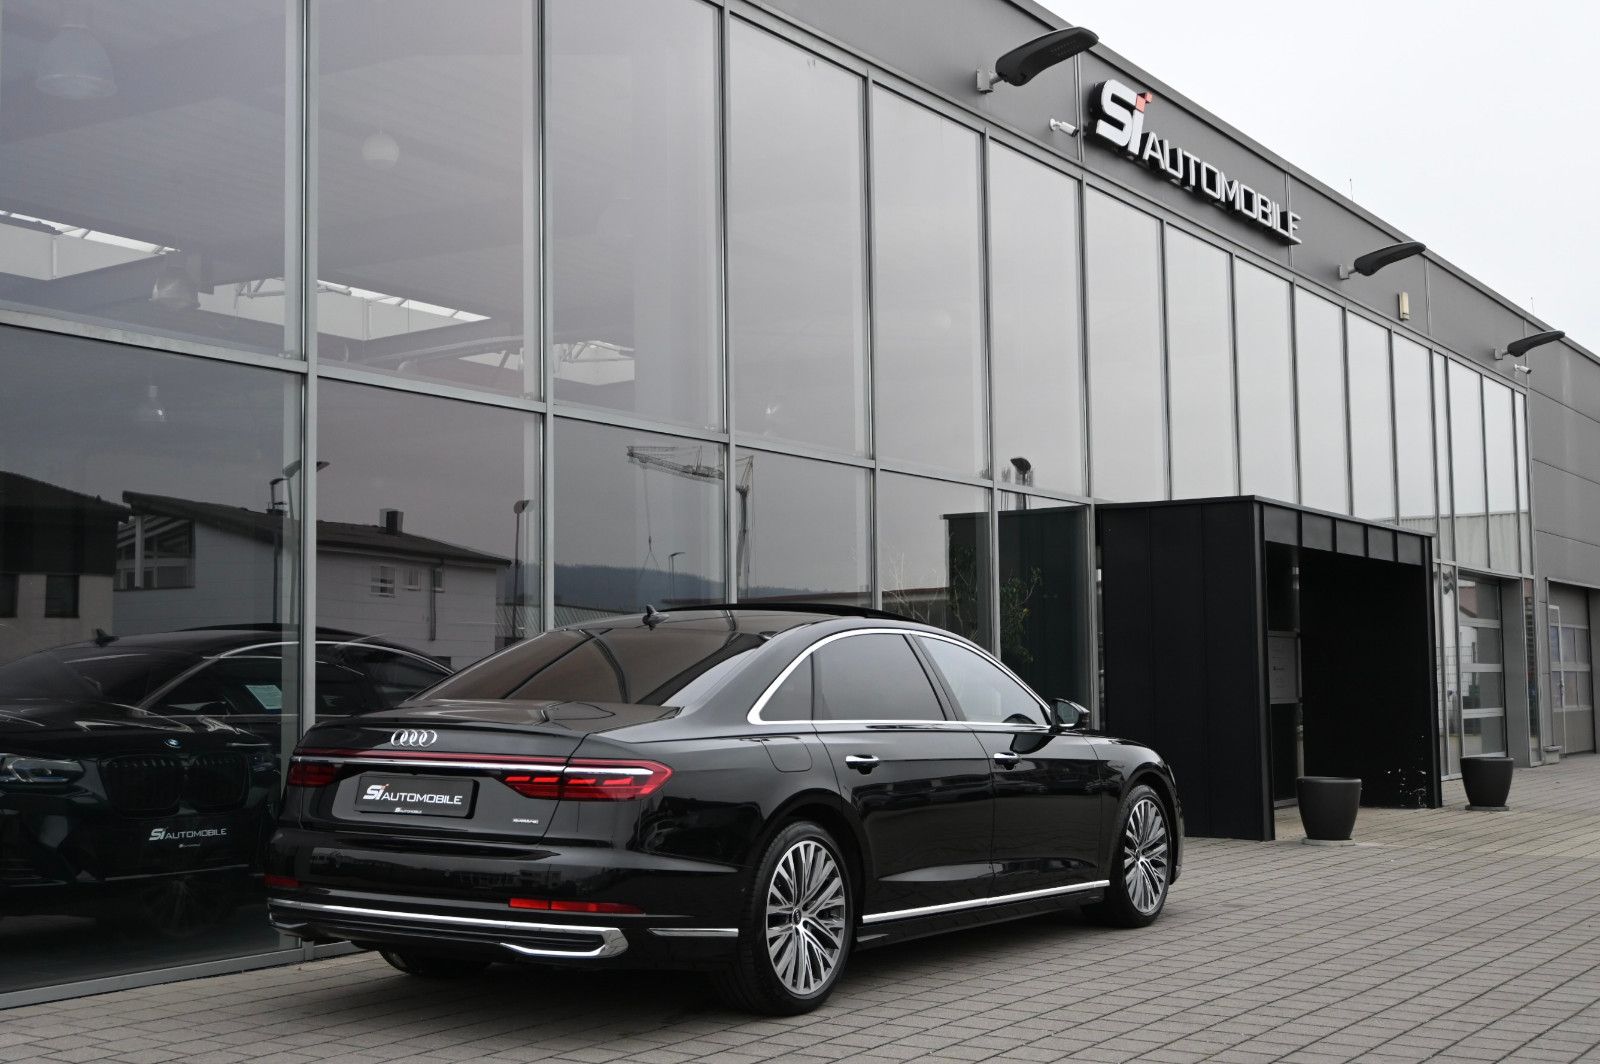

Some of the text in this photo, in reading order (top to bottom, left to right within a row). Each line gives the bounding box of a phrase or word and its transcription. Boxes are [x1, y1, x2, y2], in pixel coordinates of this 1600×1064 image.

[1142, 131, 1302, 245] AUTOMOBILE
[381, 792, 463, 805] AUTOMOBILE
[164, 828, 227, 840] AUTOMOBILE
